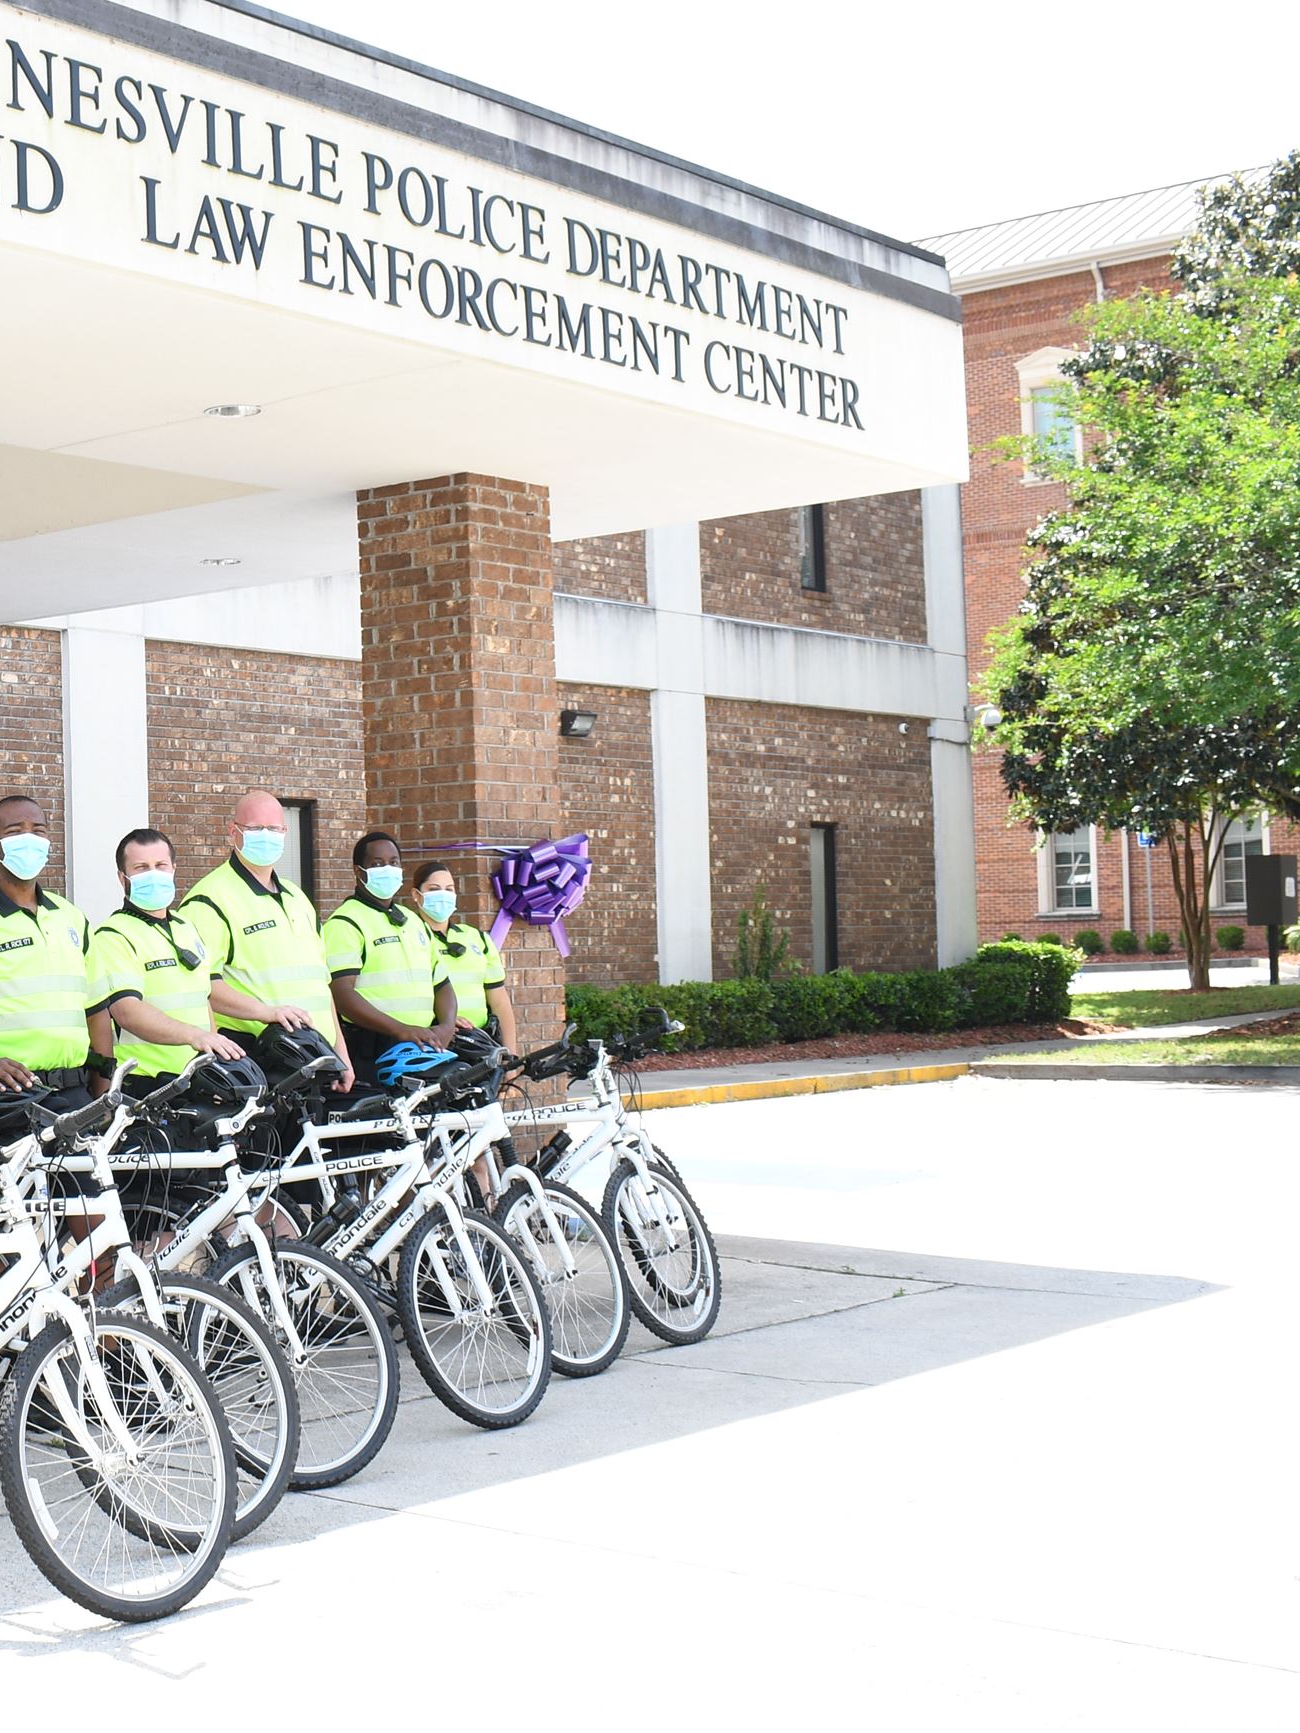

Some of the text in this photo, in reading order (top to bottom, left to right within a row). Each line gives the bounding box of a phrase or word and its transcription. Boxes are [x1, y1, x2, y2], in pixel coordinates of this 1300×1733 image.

[361, 151, 550, 265] POLICE
[563, 217, 848, 355] DEPARTMENT
[139, 176, 275, 270] LAW
[297, 220, 690, 383] ENFORCEMENT
[703, 340, 866, 431] CENTER
[373, 1114, 442, 1129] POICE
[108, 1155, 149, 1164] OLICE
[326, 1156, 384, 1172] POLICE
